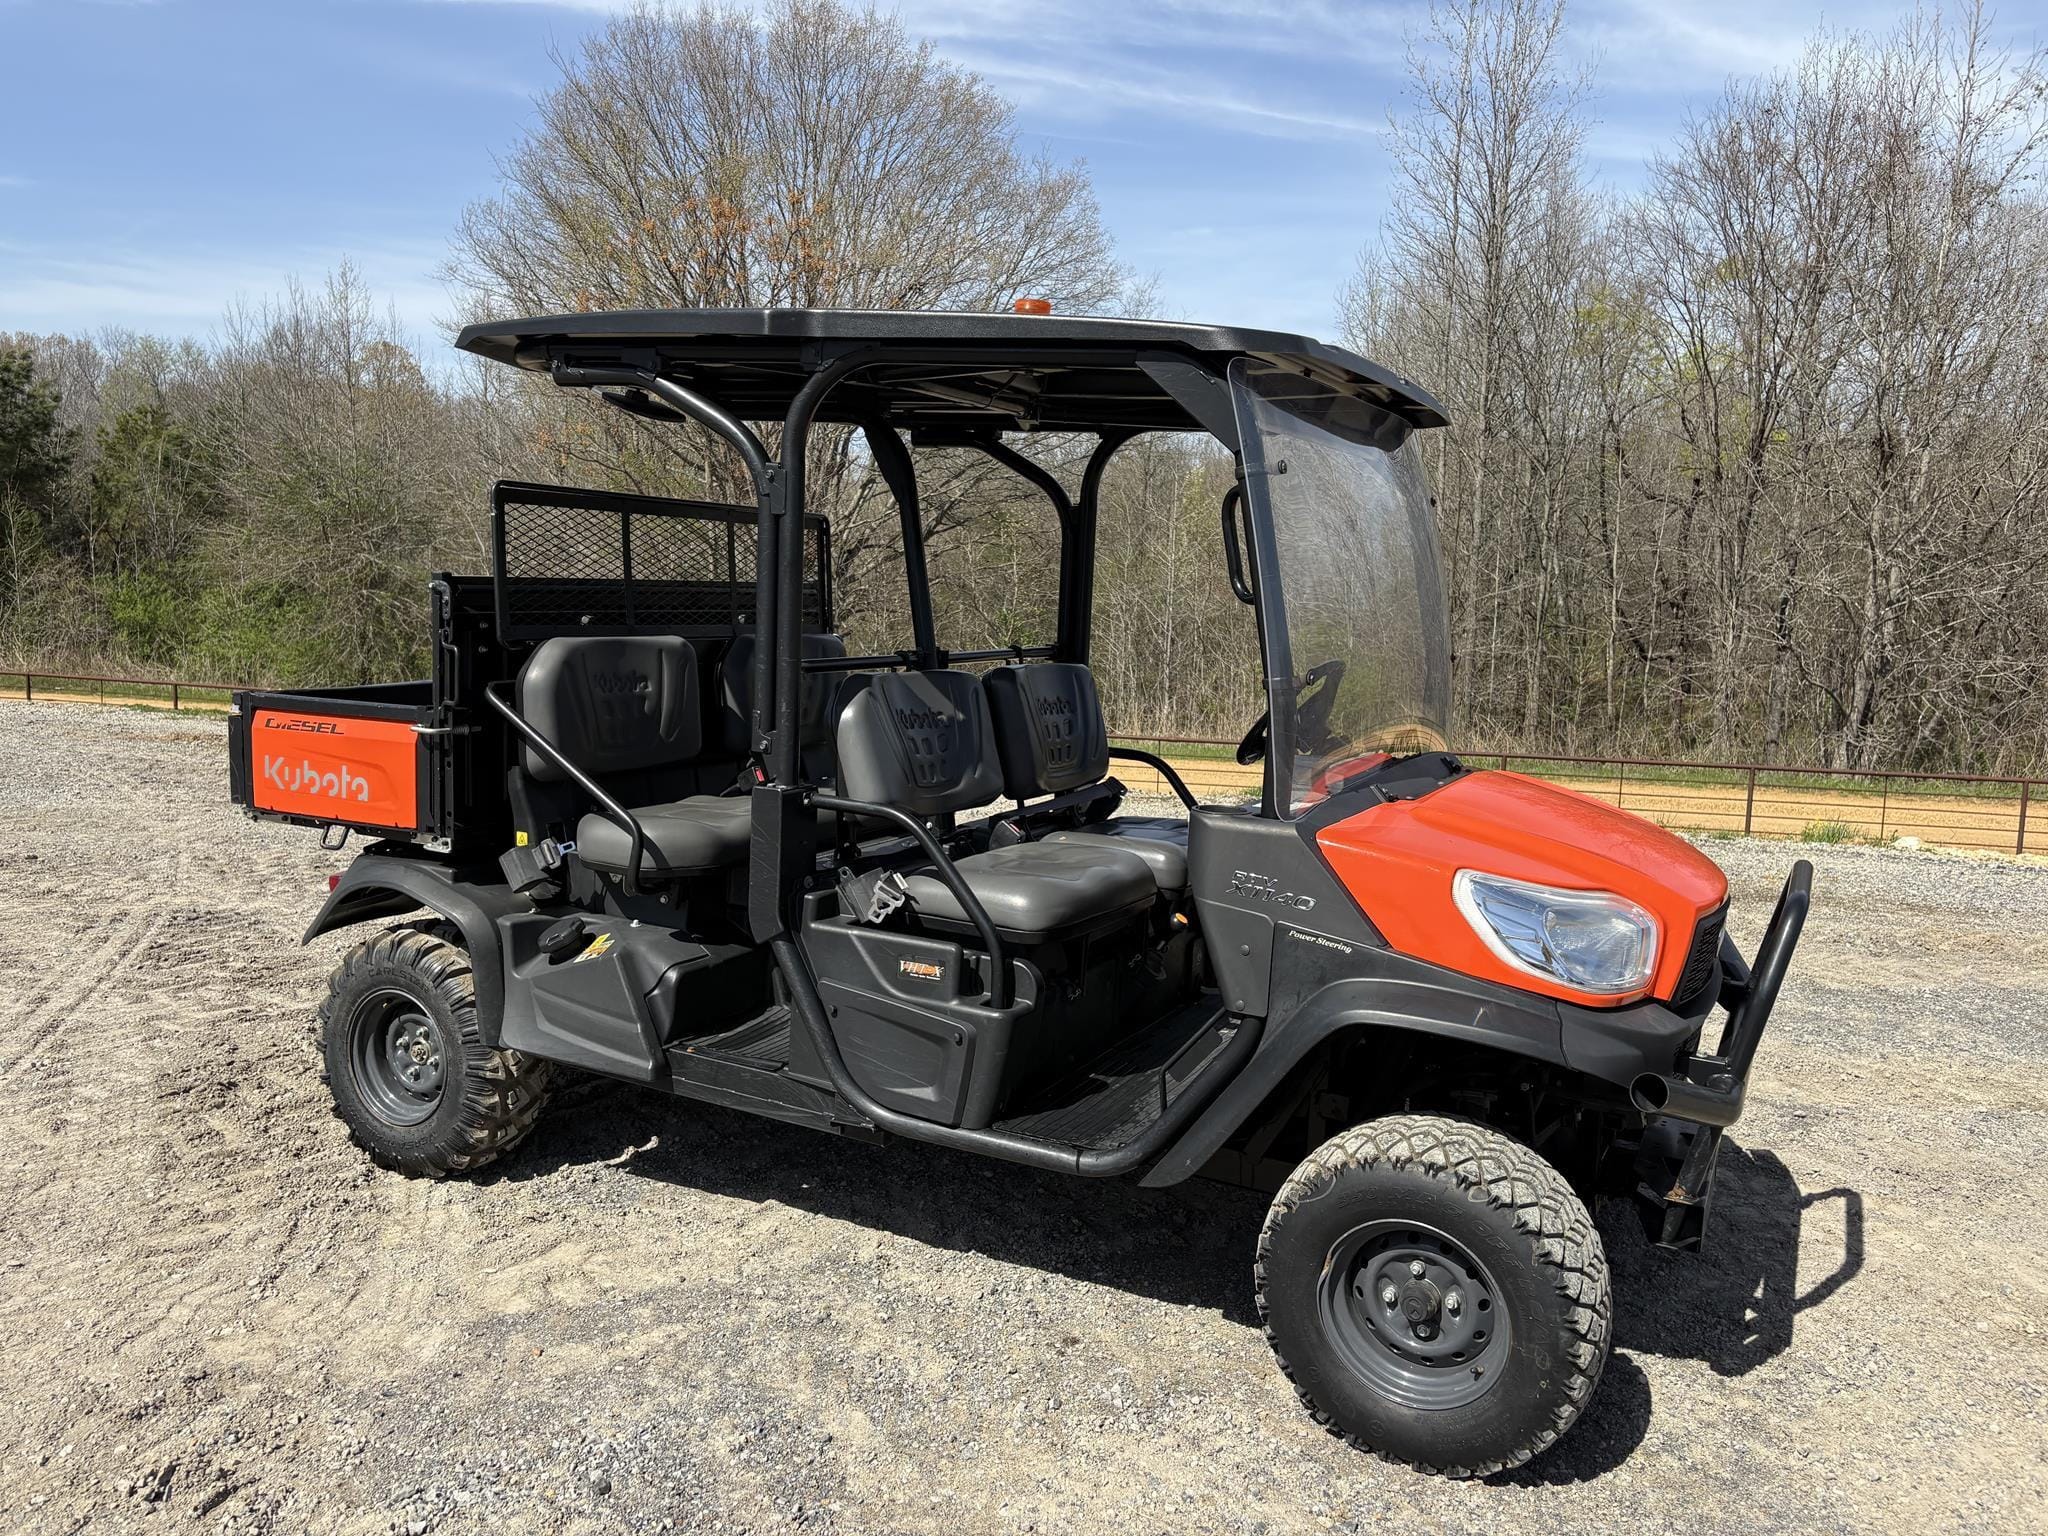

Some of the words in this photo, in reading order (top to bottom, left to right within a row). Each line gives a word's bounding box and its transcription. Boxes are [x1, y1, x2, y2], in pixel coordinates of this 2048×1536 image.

[264, 717, 345, 735] DIESEL
[264, 755, 369, 802] Kubota
[1231, 870, 1278, 888] RTV
[1289, 930, 1316, 942] Power
[1316, 937, 1352, 954] Steering
